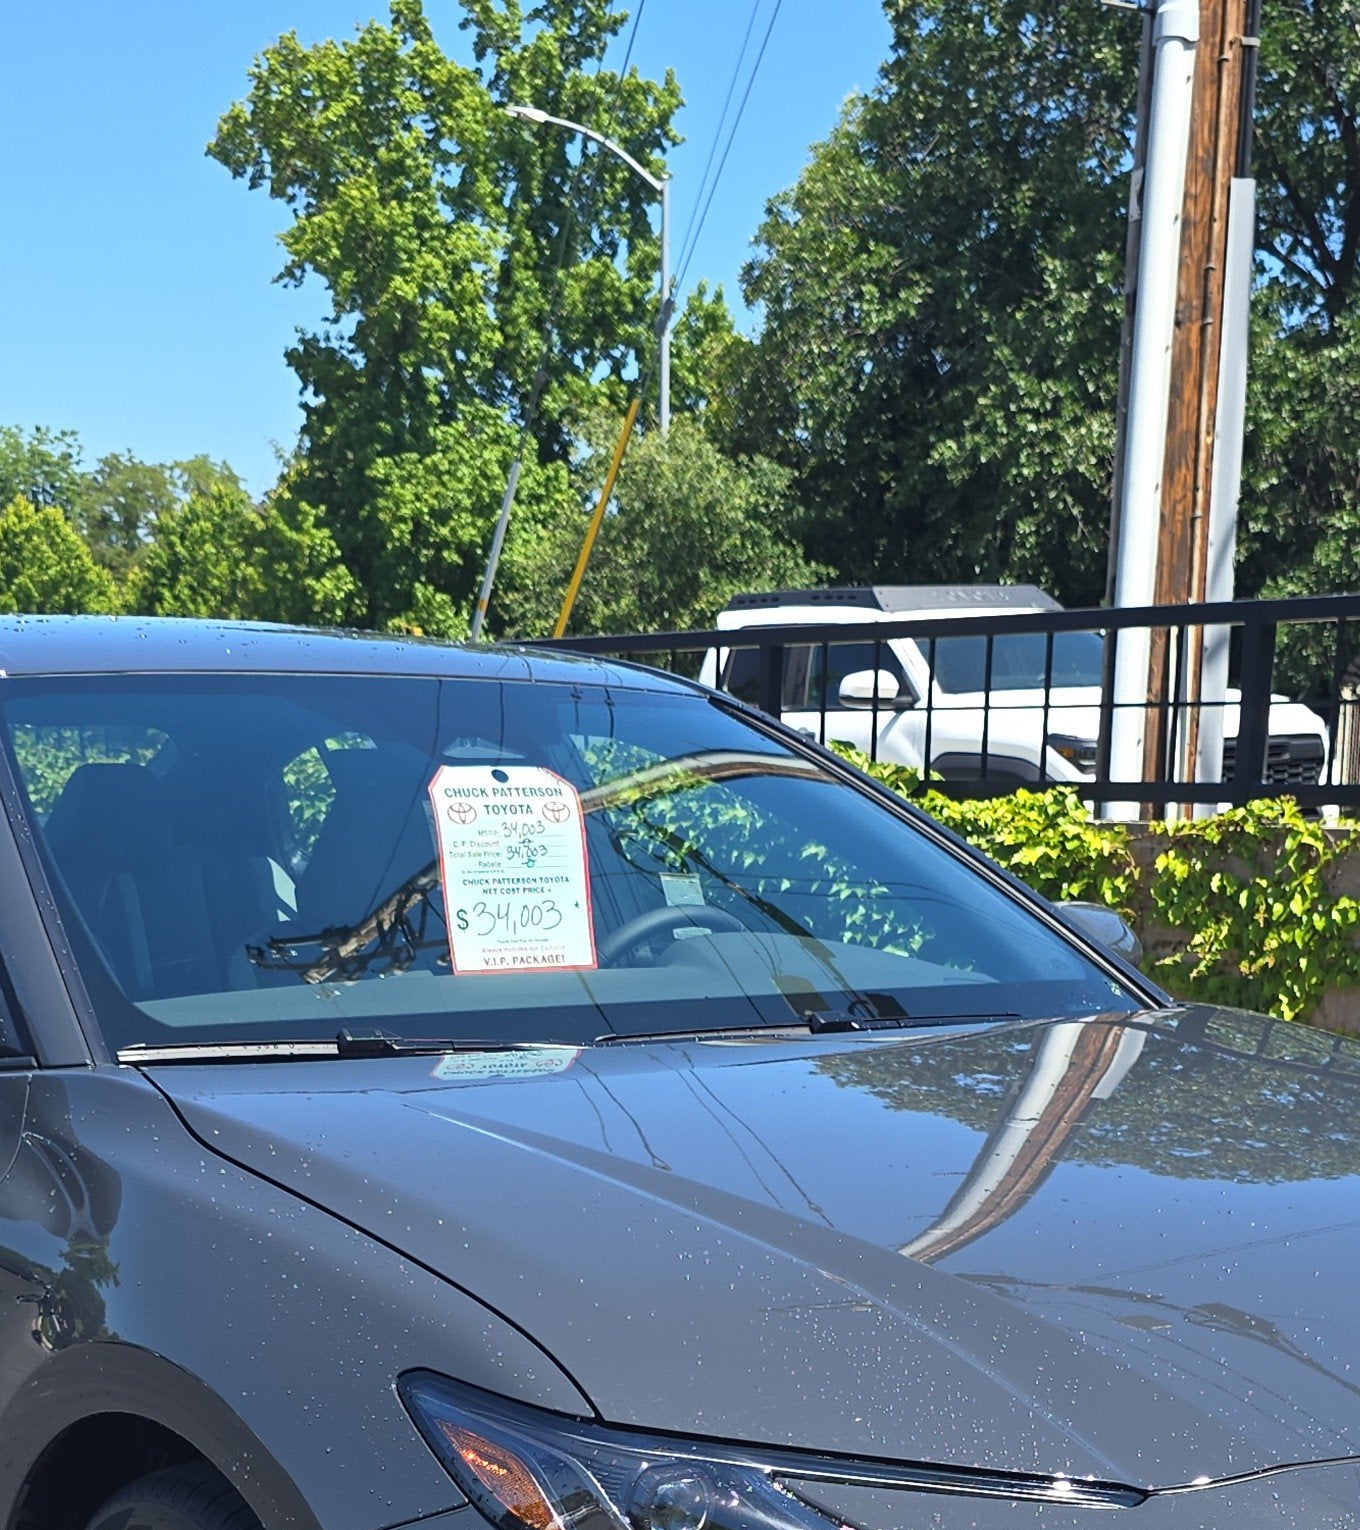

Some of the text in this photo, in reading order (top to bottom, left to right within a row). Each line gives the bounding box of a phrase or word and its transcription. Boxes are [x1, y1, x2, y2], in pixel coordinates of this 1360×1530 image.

[444, 787, 564, 798] CHUCK PATTERSON
[483, 804, 534, 816] TOYOTA
[462, 876, 570, 886] CHUCK PATTERSON TOYOTA
[500, 887, 521, 895] COST
[523, 886, 545, 894] PRICE
[483, 954, 566, 966] V.I.P. PACKAGE!
